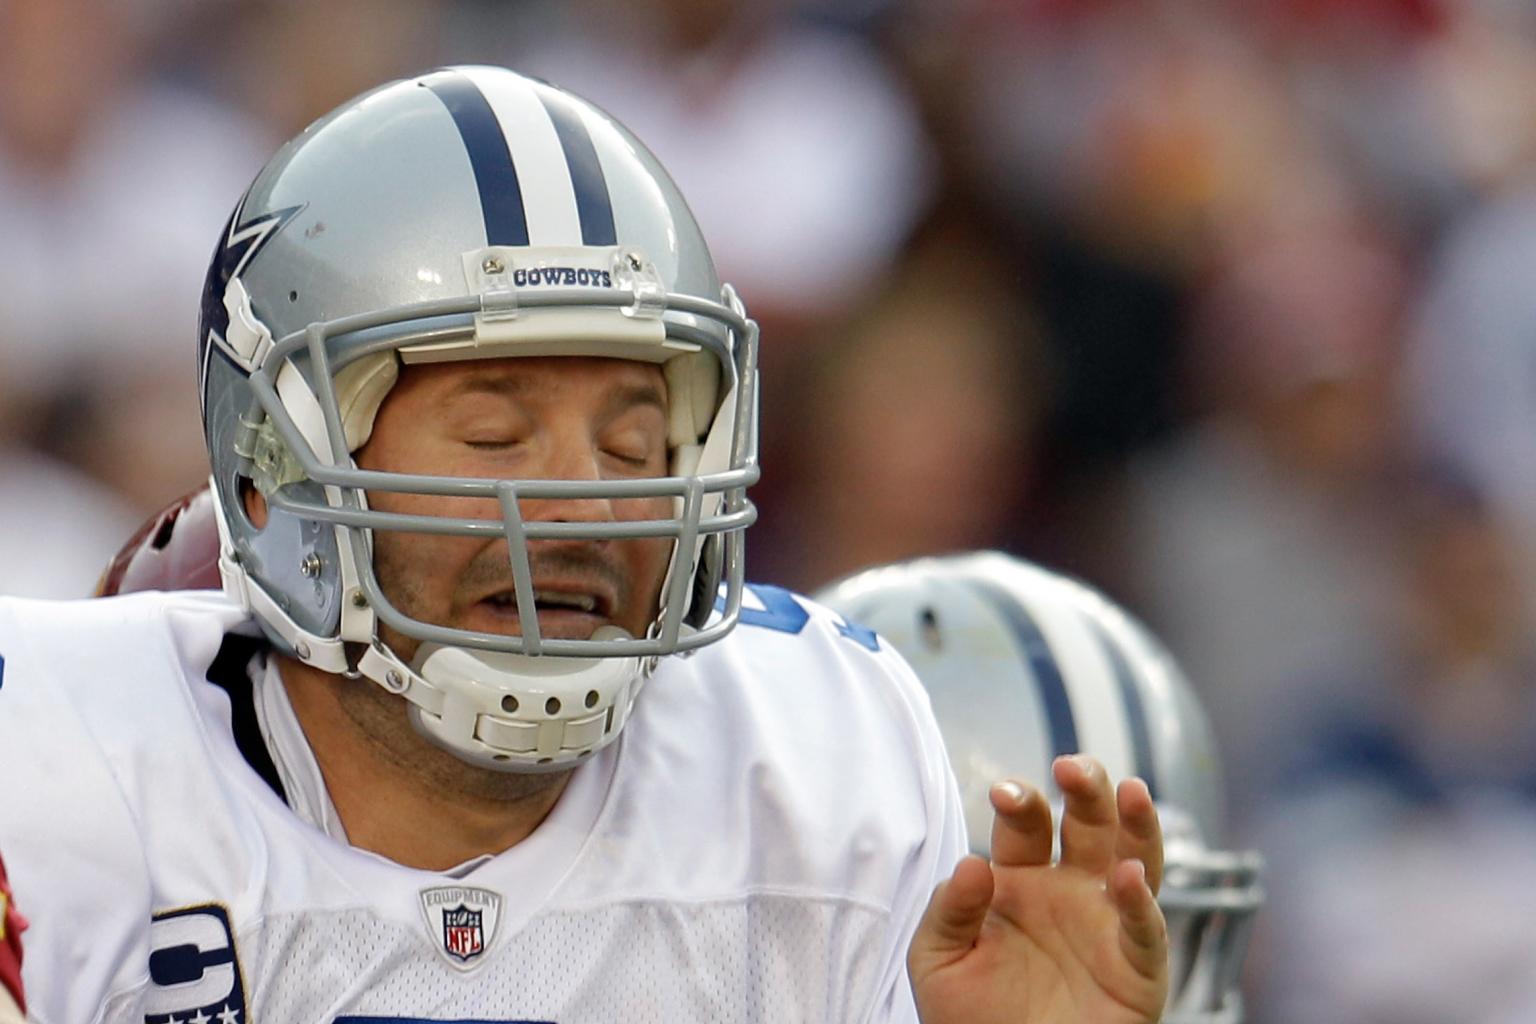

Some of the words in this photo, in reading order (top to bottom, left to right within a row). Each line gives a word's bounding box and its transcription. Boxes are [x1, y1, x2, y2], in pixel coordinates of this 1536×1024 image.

[514, 267, 612, 288] COWBOYS
[426, 890, 498, 910] EQUIPMENT
[448, 927, 481, 954] NFL
[144, 912, 235, 1016] C
